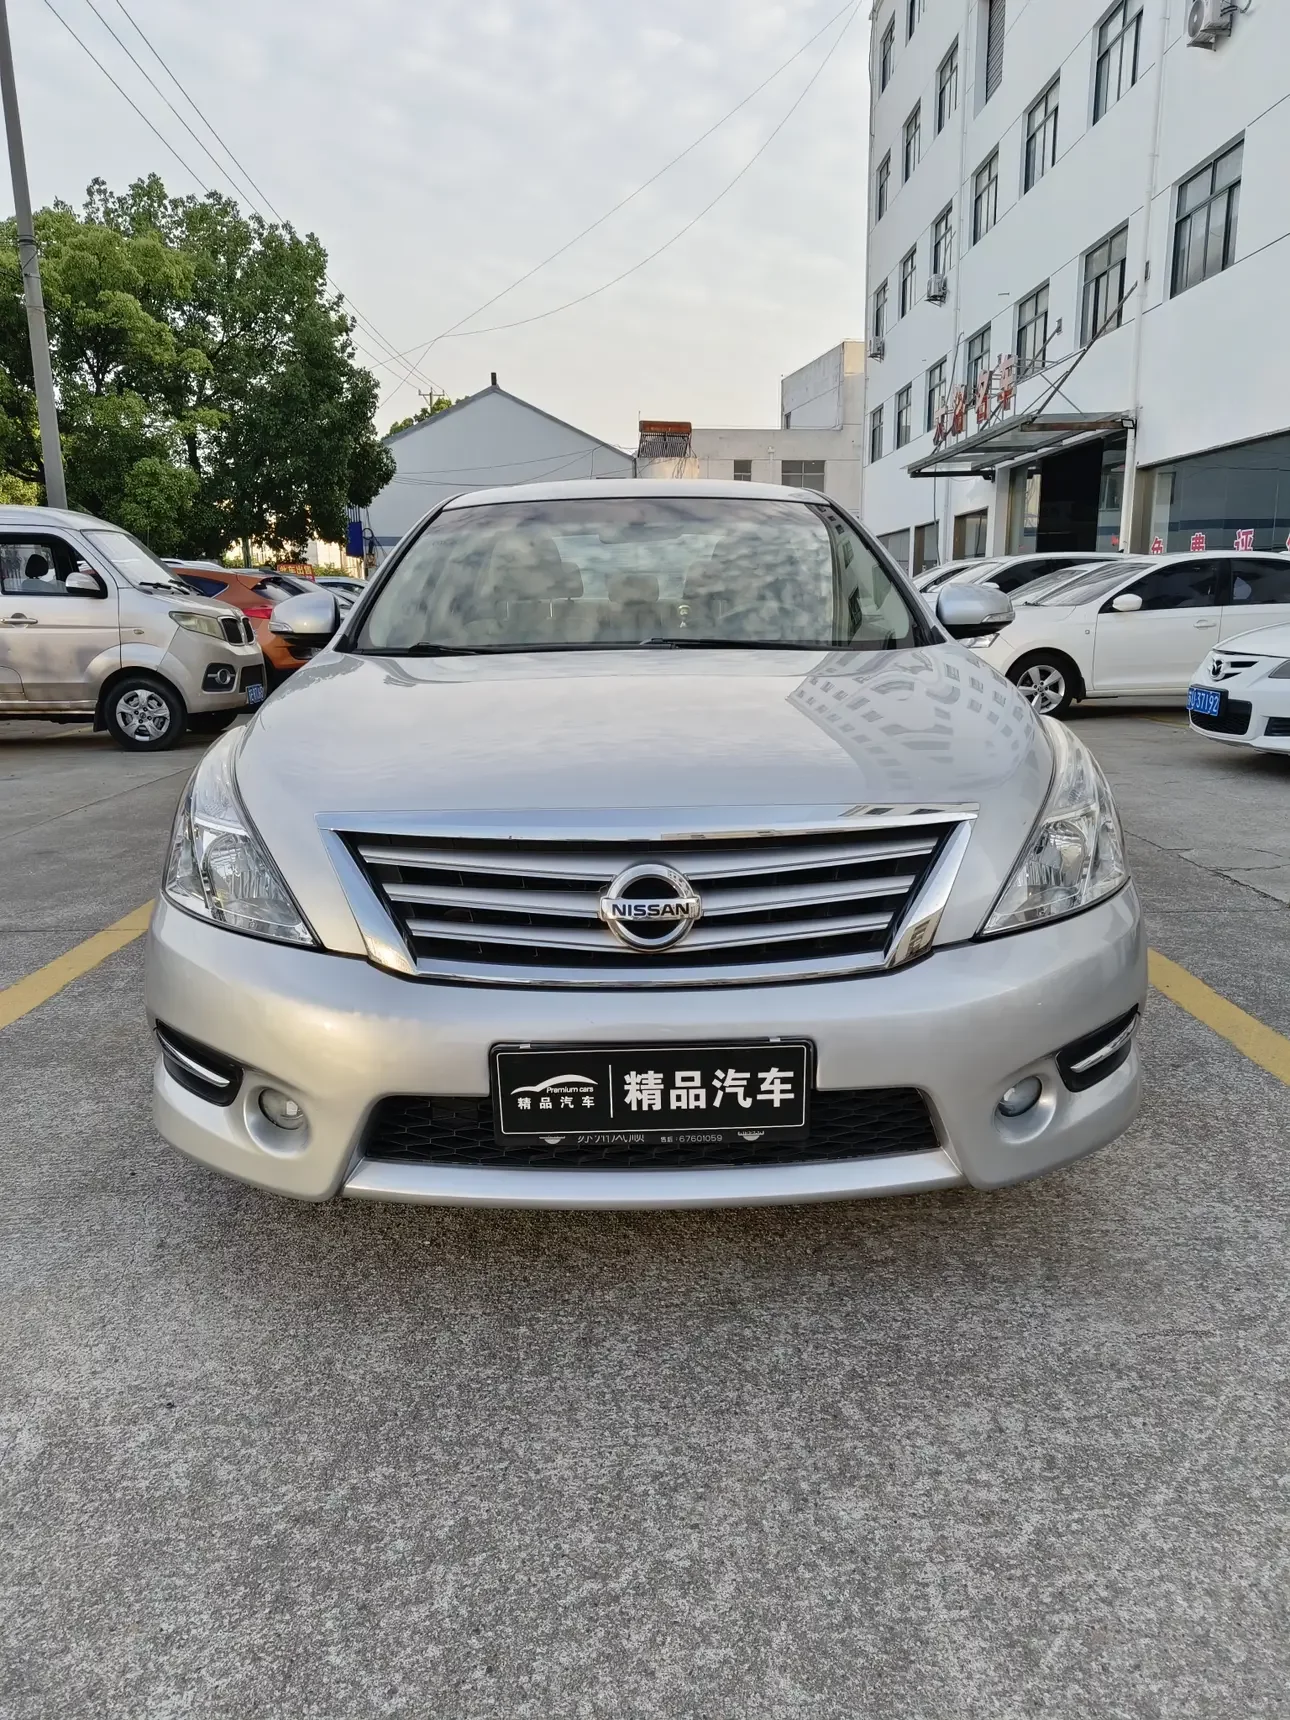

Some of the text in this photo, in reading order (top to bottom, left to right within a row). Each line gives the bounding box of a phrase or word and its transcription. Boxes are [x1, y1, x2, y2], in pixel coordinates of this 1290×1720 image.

[611, 902, 690, 917] NISSAN
[546, 1086, 578, 1094] Premium
[624, 1067, 795, 1111] 精品汽车
[517, 1095, 595, 1110] 精品汽车
